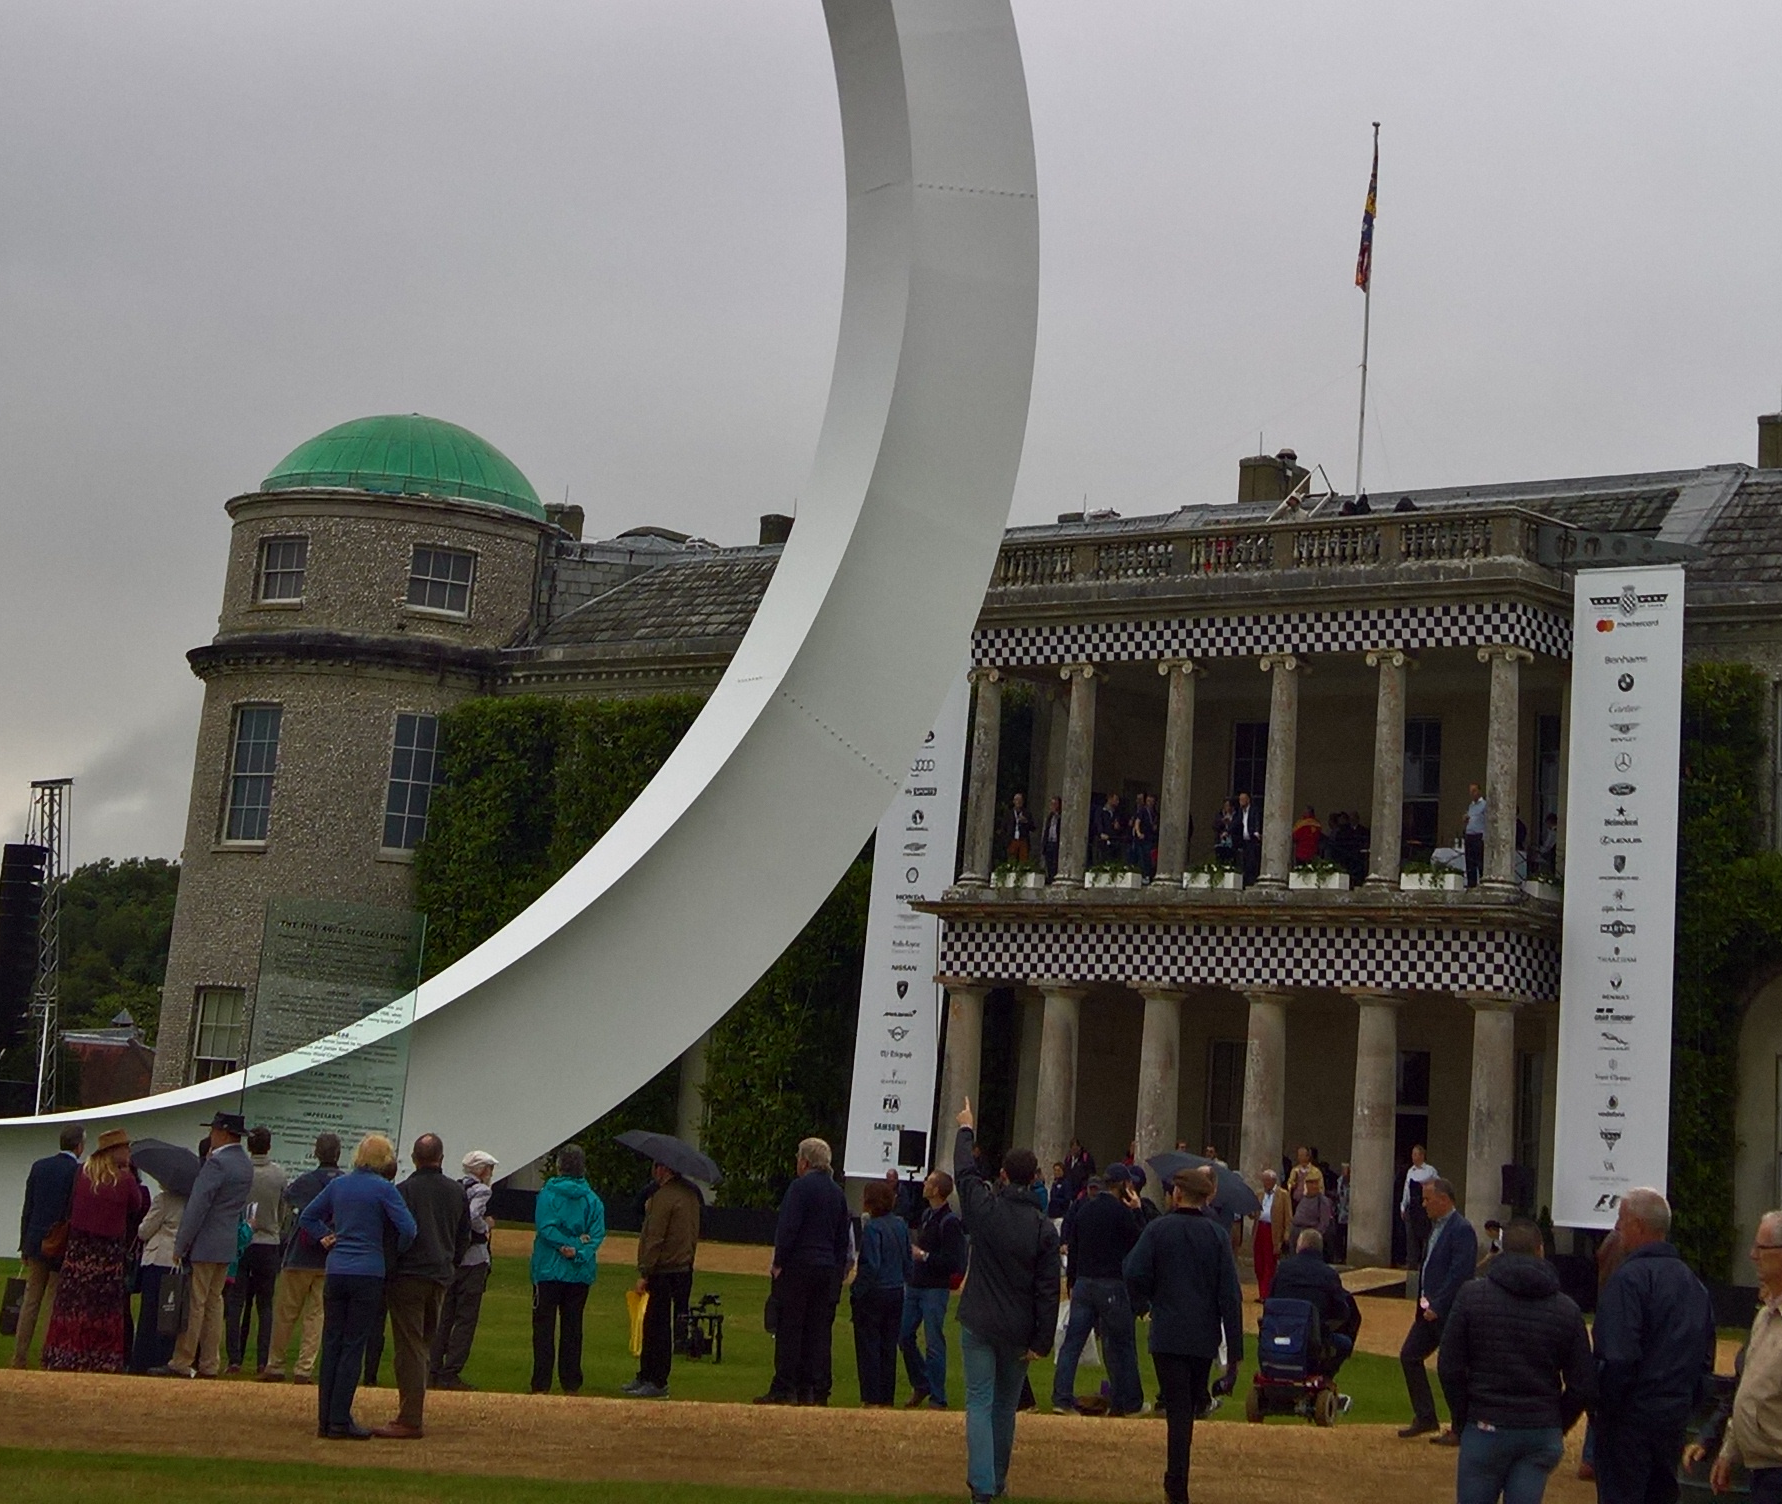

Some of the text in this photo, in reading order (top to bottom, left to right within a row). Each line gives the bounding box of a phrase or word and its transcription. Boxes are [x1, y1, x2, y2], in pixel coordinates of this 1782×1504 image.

[1604, 655, 1648, 665] Bonhams
[1603, 818, 1639, 827] Heineken
[895, 893, 926, 901] HONDA
[1601, 924, 1636, 934] MARTINI
[891, 964, 918, 972] NISSAN
[882, 1097, 900, 1111] FIA
[874, 1122, 905, 1131] SAMSUNG
